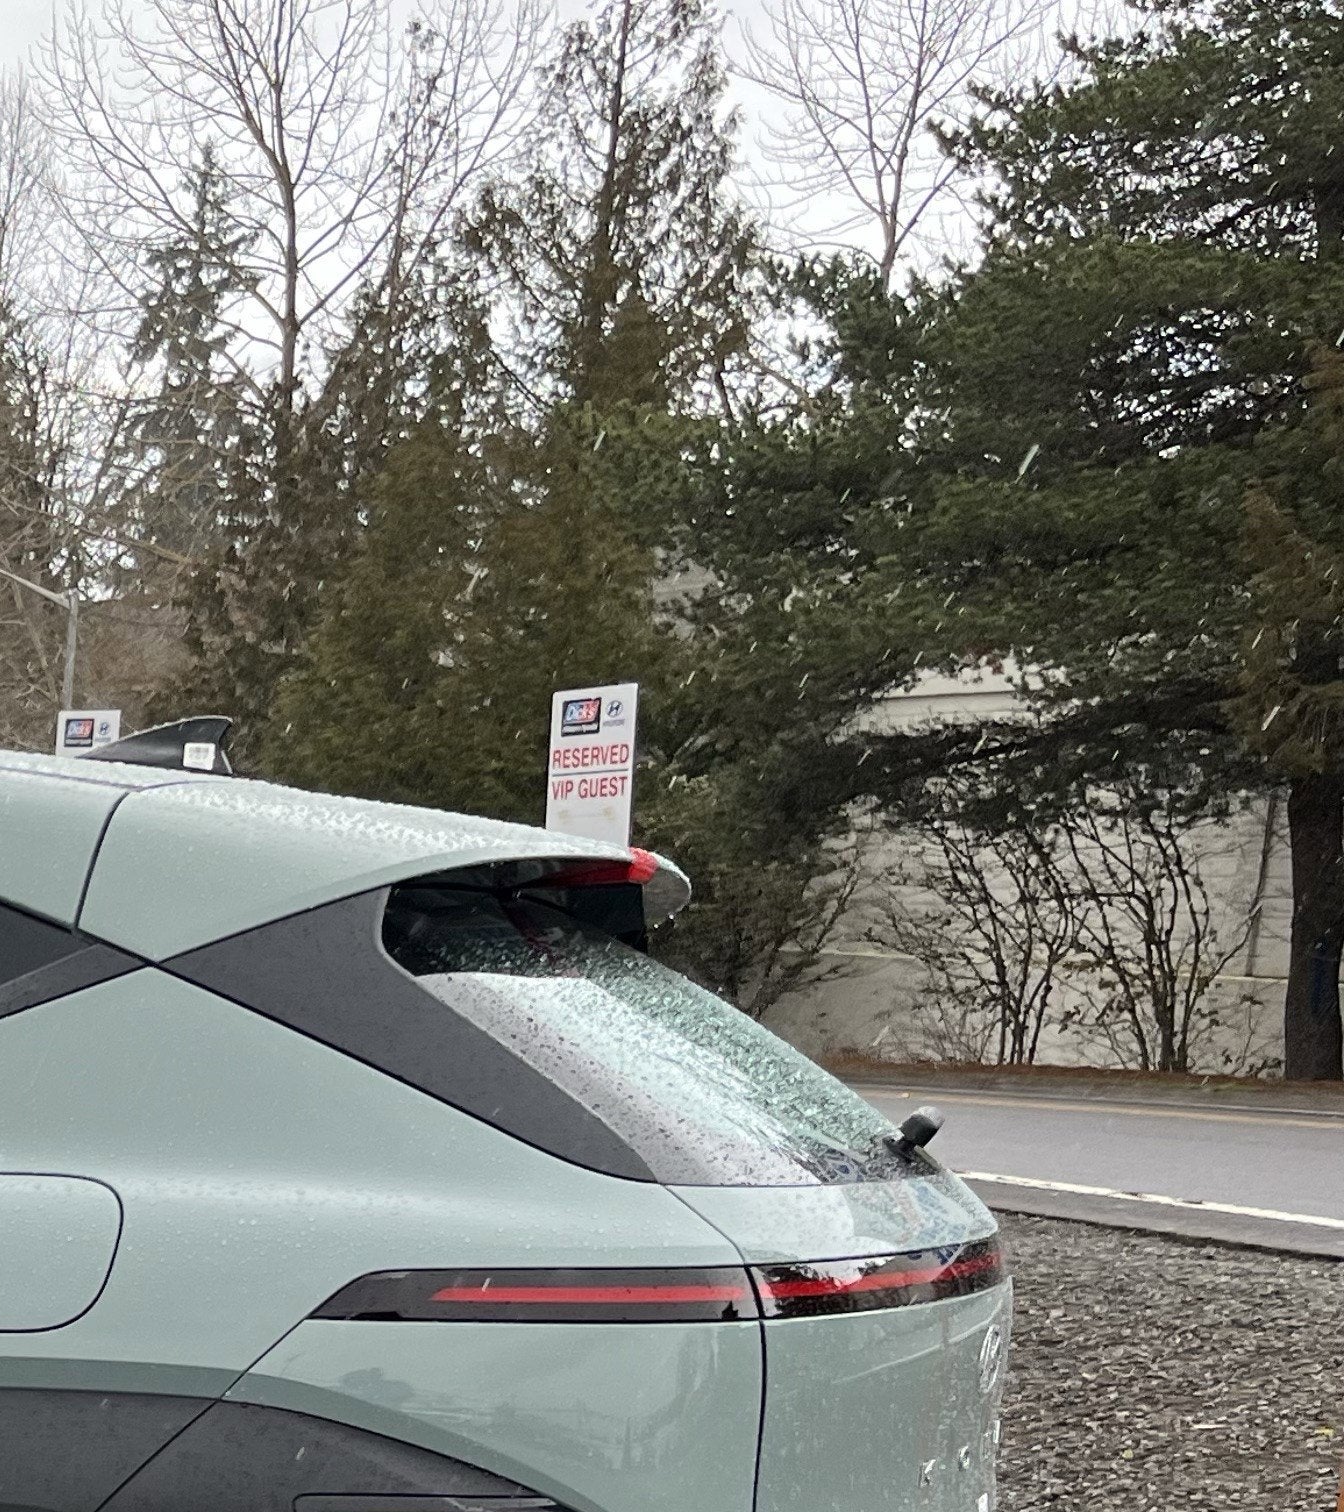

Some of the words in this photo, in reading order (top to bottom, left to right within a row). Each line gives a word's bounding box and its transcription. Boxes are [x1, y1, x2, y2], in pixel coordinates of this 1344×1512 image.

[553, 744, 629, 769] RESERVED
[552, 780, 574, 800] VIP
[578, 777, 627, 799] GUEST
